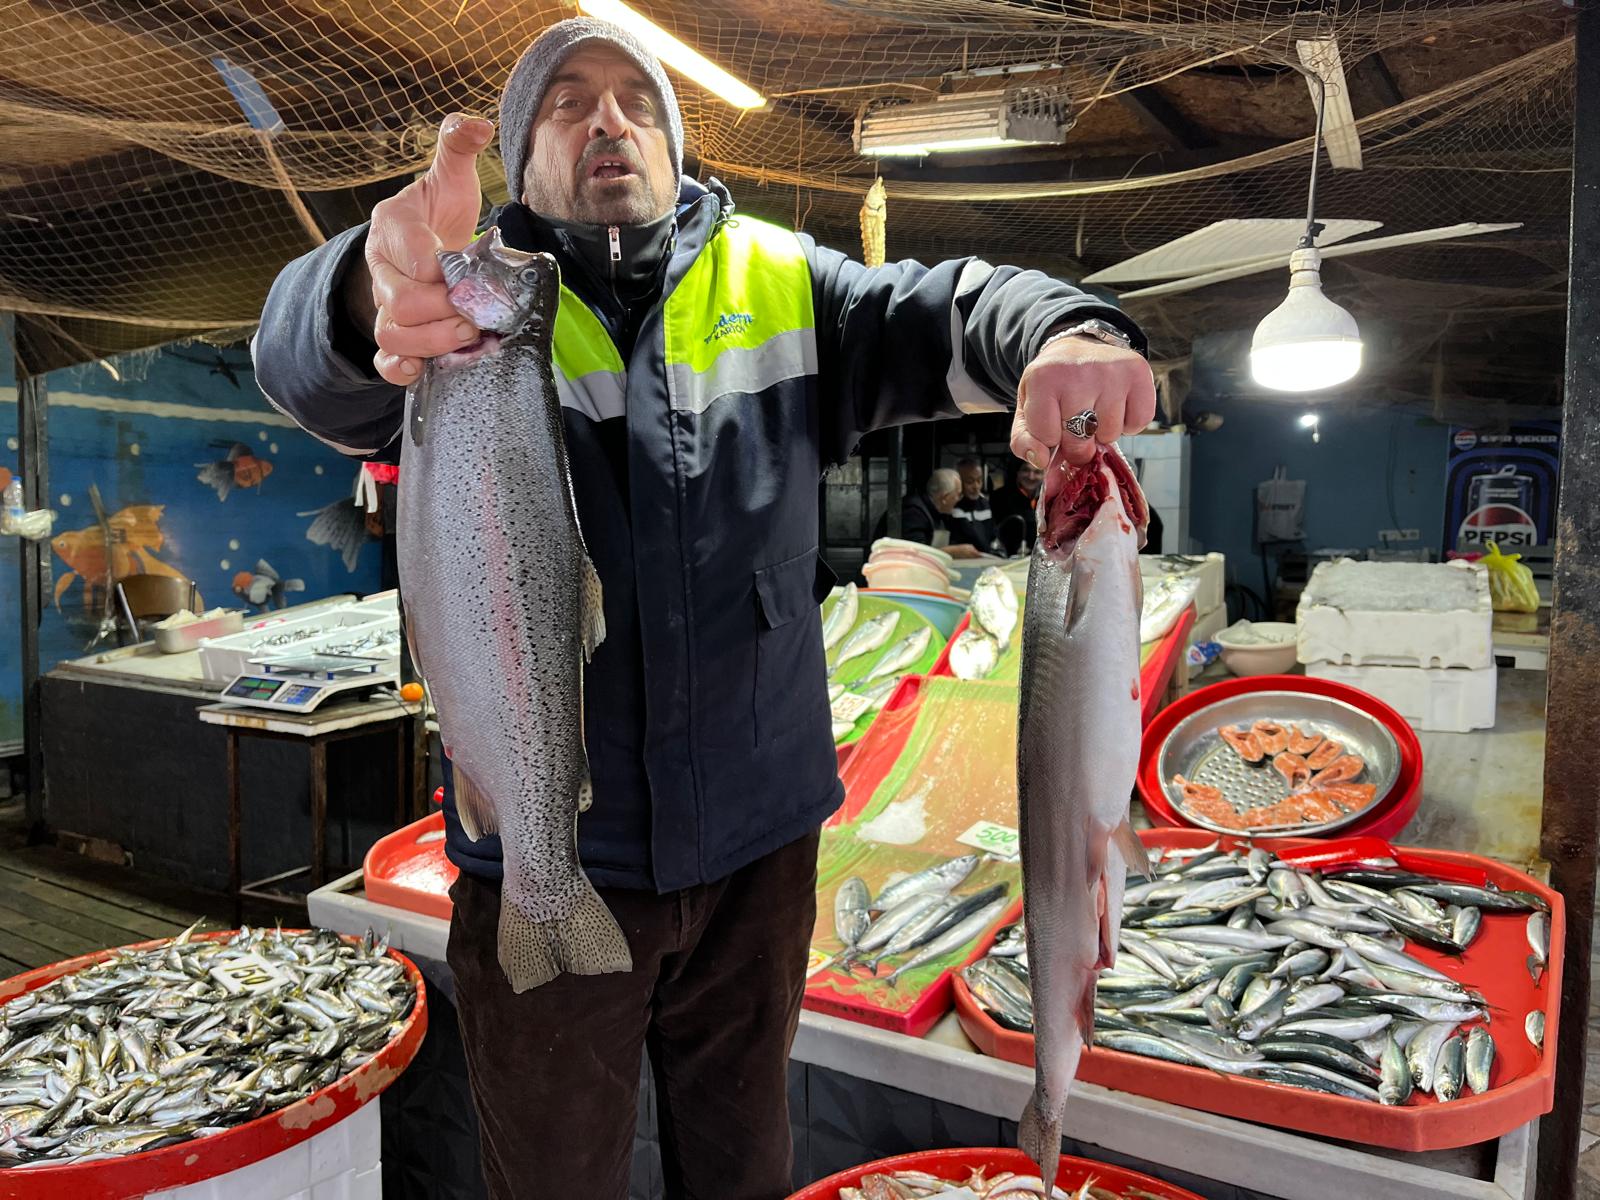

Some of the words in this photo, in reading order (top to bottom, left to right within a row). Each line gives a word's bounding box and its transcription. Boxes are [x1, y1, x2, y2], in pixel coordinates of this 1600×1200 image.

[1464, 530, 1532, 546] PEPSI
[976, 826, 1018, 843] 500
[224, 964, 274, 985] 150
